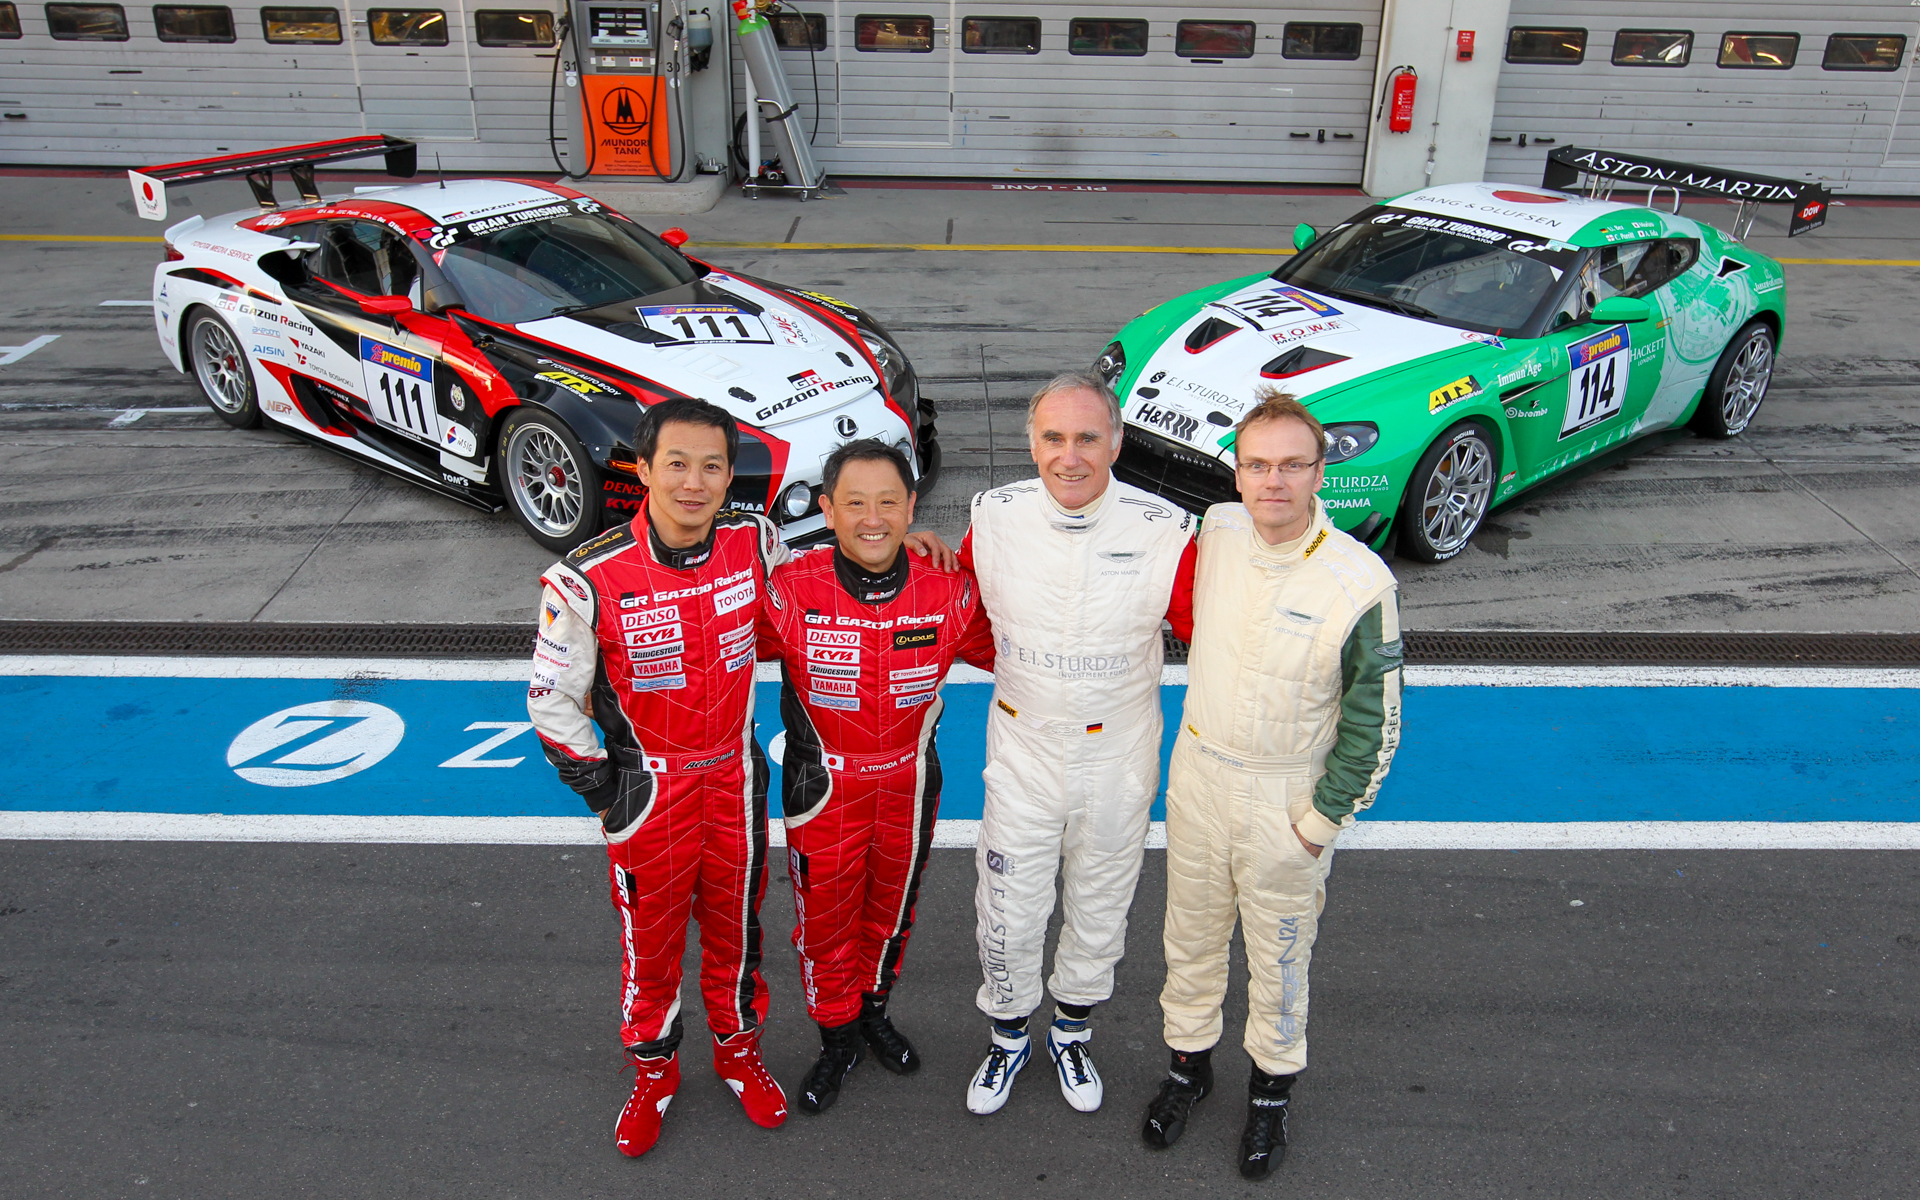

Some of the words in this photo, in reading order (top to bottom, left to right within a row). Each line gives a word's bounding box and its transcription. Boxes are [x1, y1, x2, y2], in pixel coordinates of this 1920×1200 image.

[563, 60, 577, 71] 31
[600, 139, 650, 147] MUNDOR
[614, 147, 641, 155] TANK
[1574, 151, 1677, 180] ASTON
[1680, 172, 1806, 199] MARTIN
[469, 202, 516, 215] GAZOO
[517, 195, 560, 206] Racing
[1413, 195, 1460, 206] BANG
[1480, 205, 1562, 228] OLUFSEN
[467, 215, 506, 233] GRAN
[508, 204, 569, 222] TURISMO
[489, 225, 508, 234] REAL
[508, 219, 535, 229] DRIVING
[535, 212, 574, 223] SIMULATOR
[1400, 222, 1413, 230] THE
[1429, 227, 1455, 237] DRIVING
[1455, 231, 1494, 245] SIMULATOR
[1405, 216, 1443, 228] GRAN
[1444, 221, 1507, 241] TURISMO
[227, 249, 254, 262] SERVICE
[675, 306, 739, 314] premio
[1233, 295, 1306, 317] 114
[238, 304, 278, 323] GAZOO
[280, 315, 314, 336] Racing
[671, 315, 750, 339] 111
[1271, 321, 1341, 342] ROWE
[252, 344, 285, 357] AISIN
[300, 341, 326, 358] YAZAKI
[1588, 333, 1621, 360] premio
[1629, 337, 1666, 362] HACKETT
[381, 350, 422, 373] premio
[1637, 353, 1656, 367] LONDON
[308, 362, 328, 376] TOYOTA
[537, 371, 604, 394] ATS
[550, 363, 579, 376] TOYOTA
[577, 373, 600, 385] AUTO
[598, 382, 621, 396] BODY
[792, 371, 823, 391] GR
[1166, 376, 1182, 389] E.I.
[1183, 382, 1246, 412] STURDZA
[1428, 375, 1474, 411] ATS
[1578, 356, 1615, 420] 114
[379, 372, 429, 435] 111
[755, 387, 820, 421] GAZOO
[820, 374, 873, 393] Racing
[265, 400, 292, 415] NEXT
[1517, 407, 1548, 418] brembo
[456, 437, 473, 452] MSIG
[442, 472, 469, 486] TOM'S
[1321, 474, 1389, 488] STURDZA
[730, 501, 765, 512] PIAA
[1322, 497, 1371, 509] KOHAMA
[587, 531, 624, 550] LEXUS
[620, 595, 648, 609] GR
[653, 583, 713, 602] GAZOO
[714, 567, 753, 589] Racing
[717, 587, 755, 609] TOYOTA
[625, 608, 676, 628] DENSO
[804, 614, 831, 625] GR
[835, 616, 893, 630] GAZOO
[896, 613, 945, 626] Racing
[633, 627, 675, 644] KYB
[809, 631, 858, 645] DENSO
[907, 633, 935, 641] LEXUS
[1274, 626, 1294, 637] ASTON
[1294, 631, 1314, 641] MARTIN
[541, 637, 567, 653] YAZAKI
[631, 644, 683, 659] BRIDGESTONE
[549, 658, 570, 668] SERVICE
[813, 649, 854, 661] KYB
[1019, 647, 1040, 666] E.I.
[1044, 653, 1130, 672] STURDZA
[636, 660, 679, 675] YAMAHA
[809, 665, 858, 676] BRIDGESTONE
[1058, 671, 1107, 679] INVESTMENT
[1109, 667, 1131, 677] FUNDS
[534, 672, 555, 686] MSIG
[634, 677, 684, 688] akebono
[814, 681, 853, 693] YAMAHA
[529, 688, 553, 698] EXT
[811, 693, 857, 707] akebono
[898, 693, 933, 706] AISIN
[1380, 705, 1398, 772] OLUFSEN
[860, 760, 898, 773] A.TOYODA
